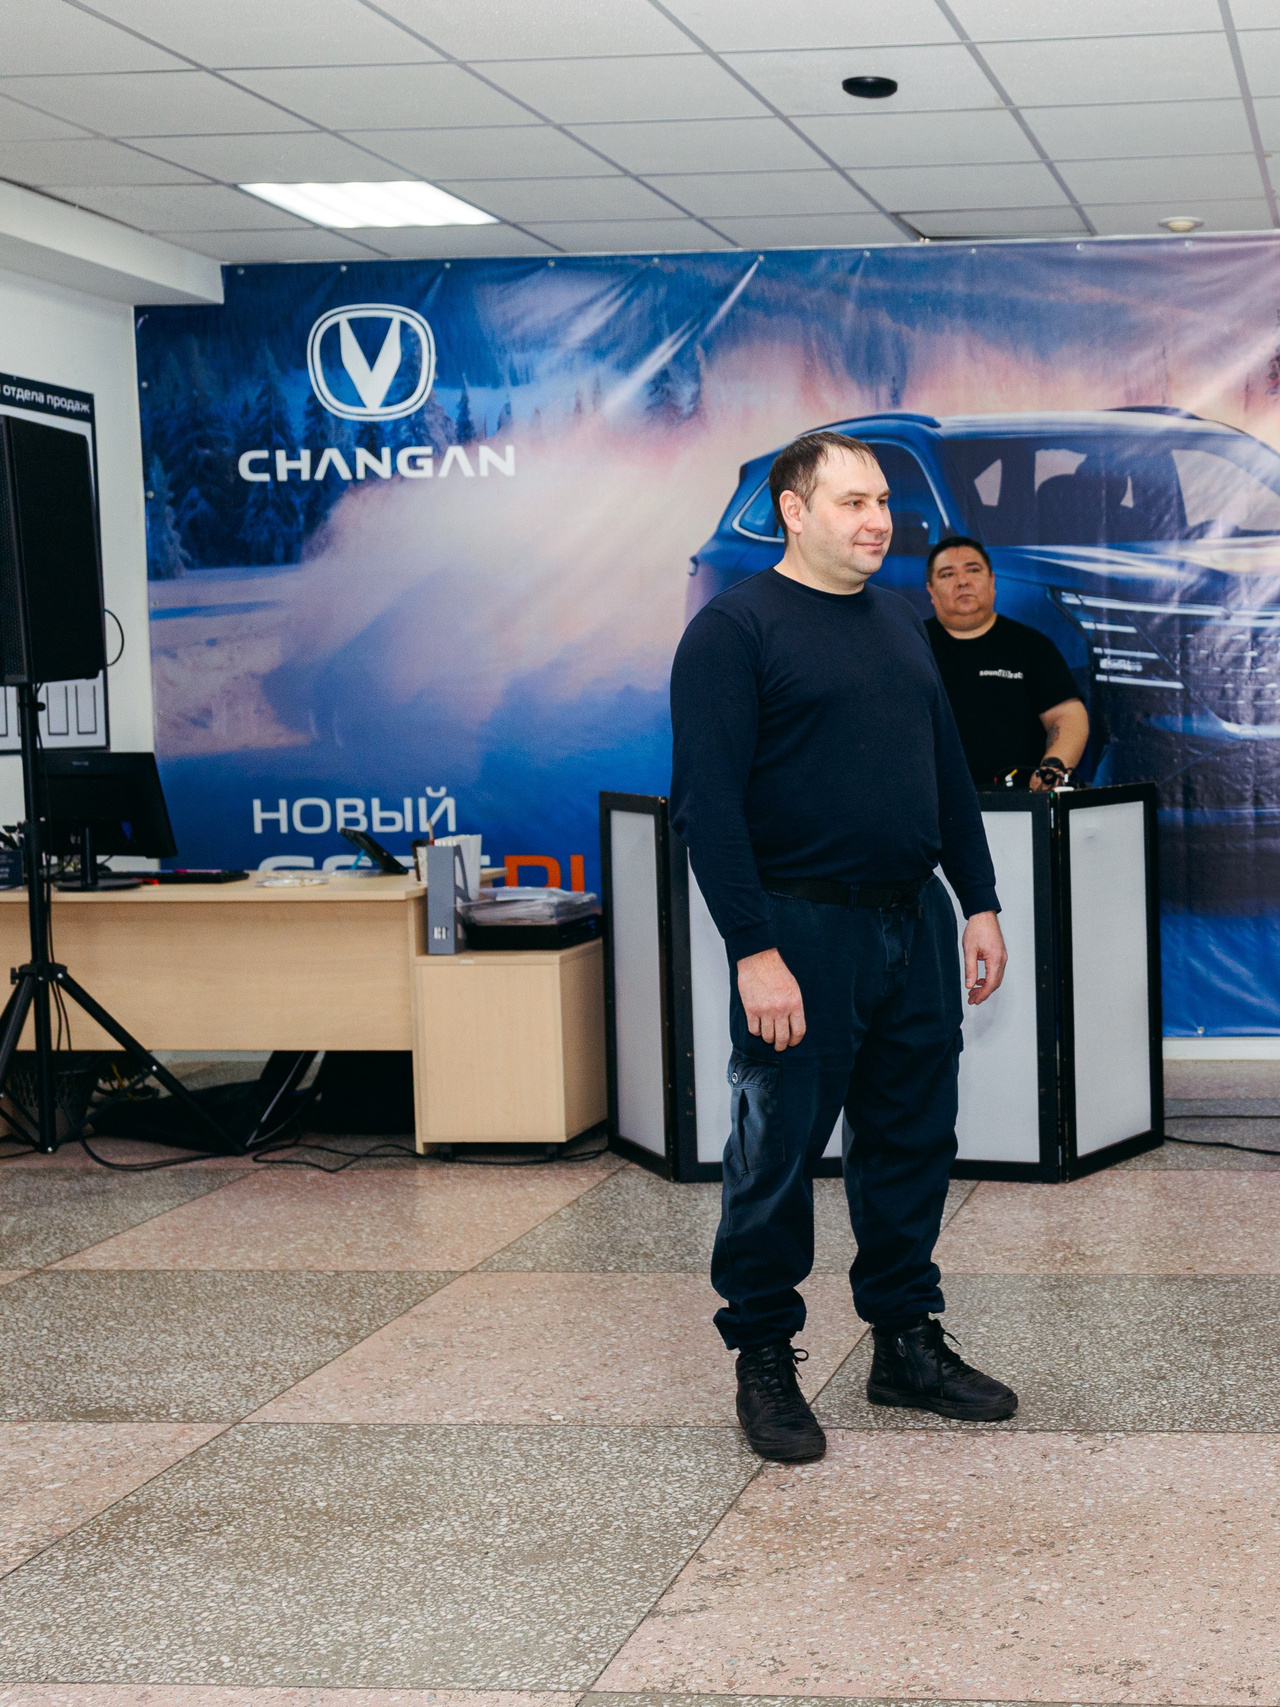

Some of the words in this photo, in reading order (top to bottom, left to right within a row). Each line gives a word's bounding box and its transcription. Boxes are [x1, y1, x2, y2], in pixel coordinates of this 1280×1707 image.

[3, 384, 45, 404] отдела
[46, 393, 91, 414] продаж
[237, 445, 516, 482] CHANGAN
[252, 786, 457, 835] НОВЫЙ
